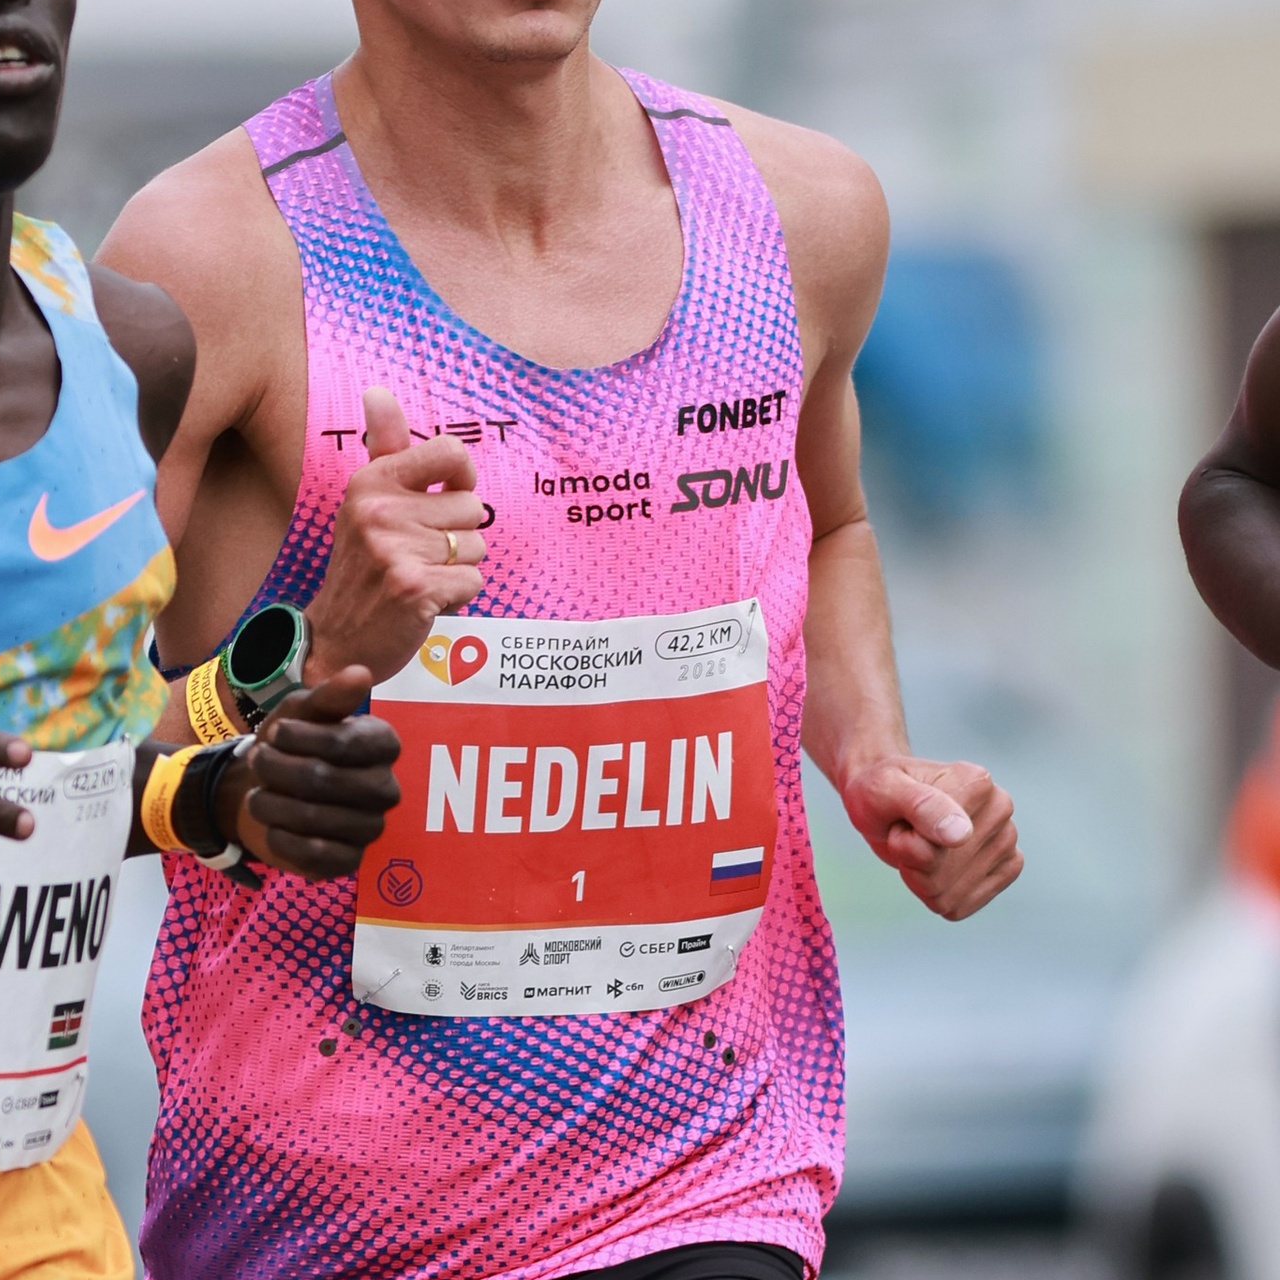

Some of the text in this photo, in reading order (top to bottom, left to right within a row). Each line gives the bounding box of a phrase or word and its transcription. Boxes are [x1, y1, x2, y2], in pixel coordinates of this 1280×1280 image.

[677, 390, 787, 436] FONBET
[534, 469, 651, 497] lamoda
[670, 459, 790, 514] SONU
[567, 499, 652, 526] sport
[501, 636, 610, 651] СБЕРПРАЙМ
[667, 632, 705, 654] 42,2
[500, 647, 643, 670] МОСКОВСКИЙ
[677, 657, 727, 682] 2026
[499, 672, 608, 690] МАРАФОН
[424, 731, 733, 834] NEDELIN
[571, 870, 586, 902] 1
[544, 936, 602, 953] МОСКОВСКИЙ
[639, 942, 676, 954] СБЕР
[543, 953, 571, 966] СПОРТ
[662, 974, 696, 988] WINLINE
[477, 991, 508, 1001] BRICS
